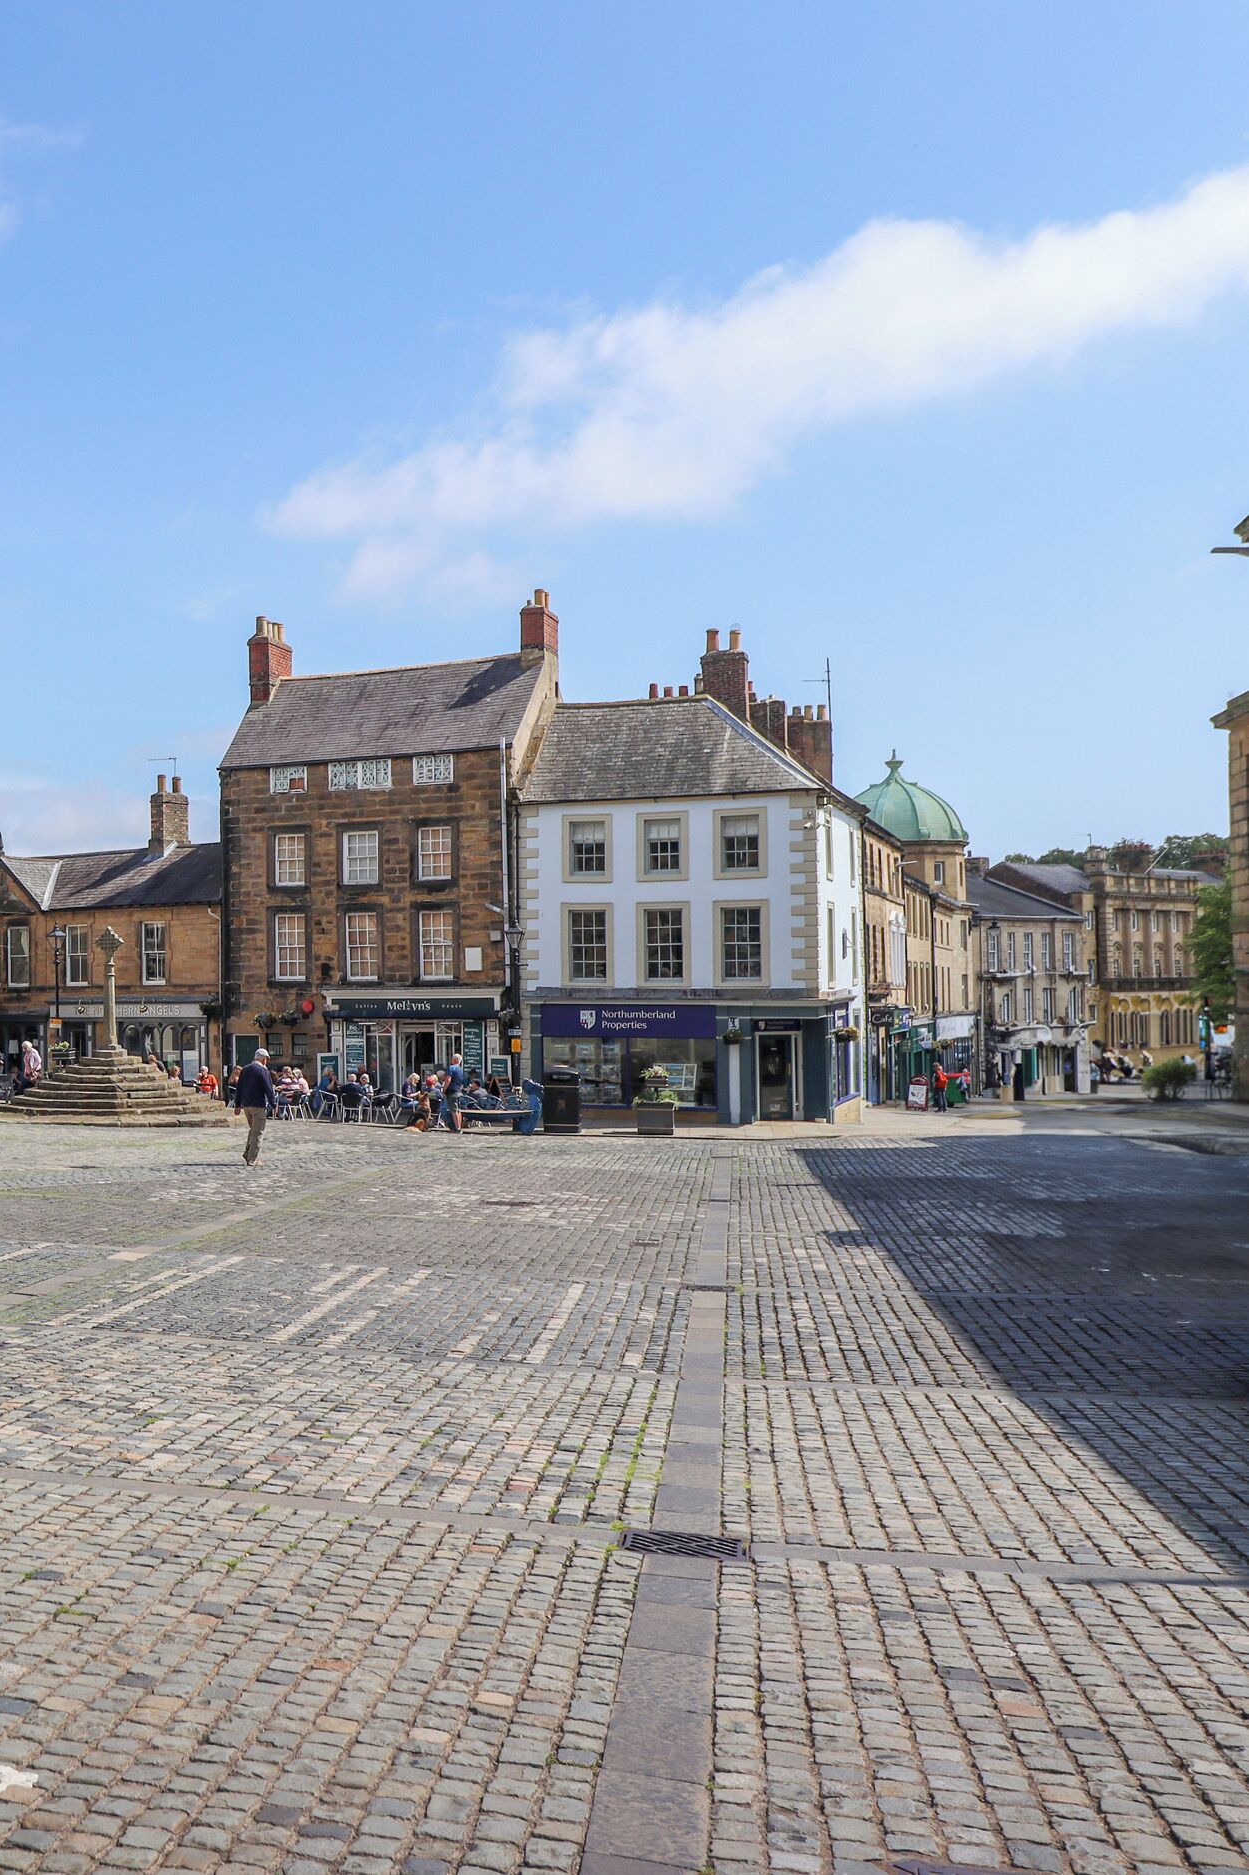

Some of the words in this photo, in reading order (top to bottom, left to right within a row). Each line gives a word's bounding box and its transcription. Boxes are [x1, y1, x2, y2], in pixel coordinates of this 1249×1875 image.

[602, 1009, 675, 1019] Northumberland
[872, 1012, 892, 1024] Café
[602, 1020, 648, 1030] Properties
